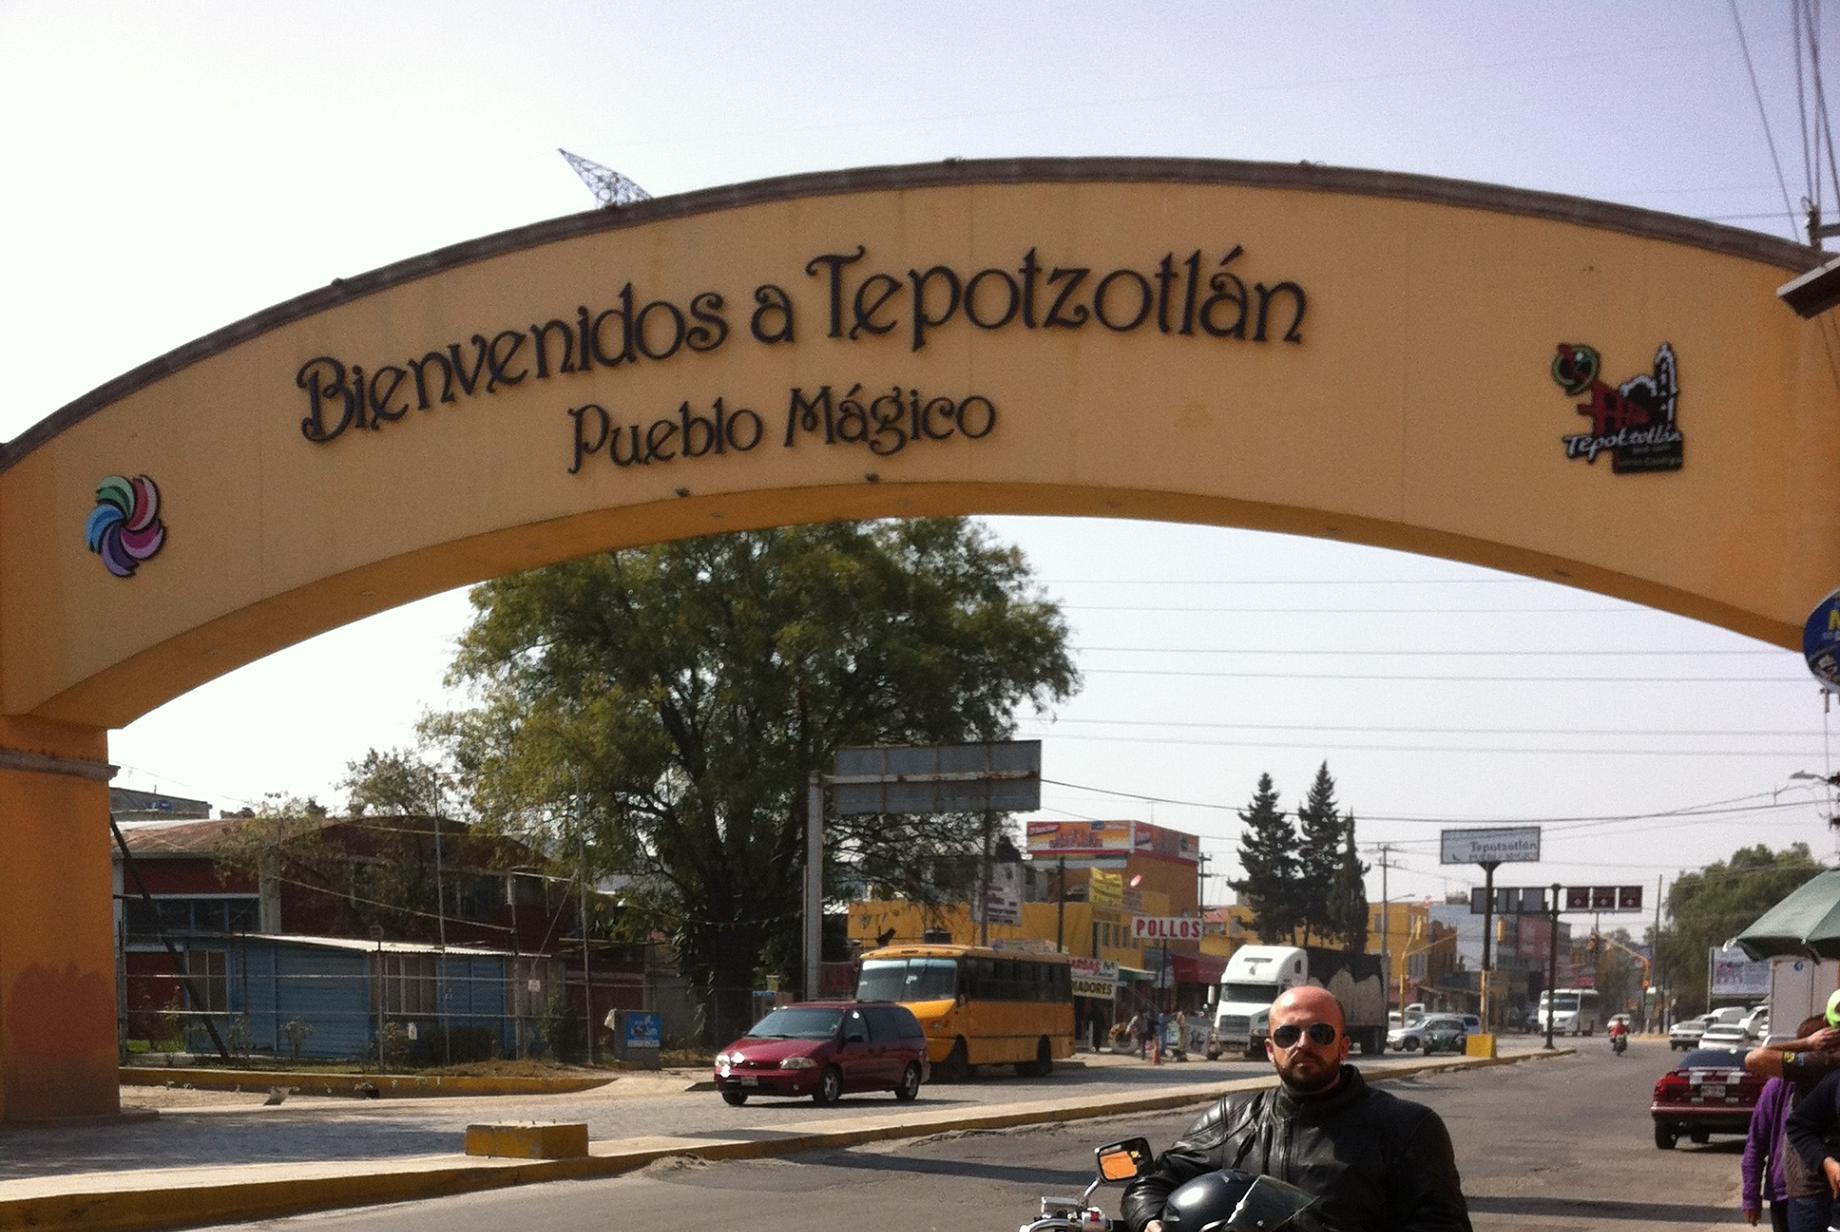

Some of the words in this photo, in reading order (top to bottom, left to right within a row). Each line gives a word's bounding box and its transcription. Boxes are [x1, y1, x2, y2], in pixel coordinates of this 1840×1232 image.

[295, 281, 730, 443] Bienvenidos
[749, 283, 796, 345] a
[804, 244, 1308, 352] Tepotzotlán
[567, 397, 764, 474] Pueblo
[783, 382, 997, 456] Mágico
[1136, 918, 1201, 938] POLLOS
